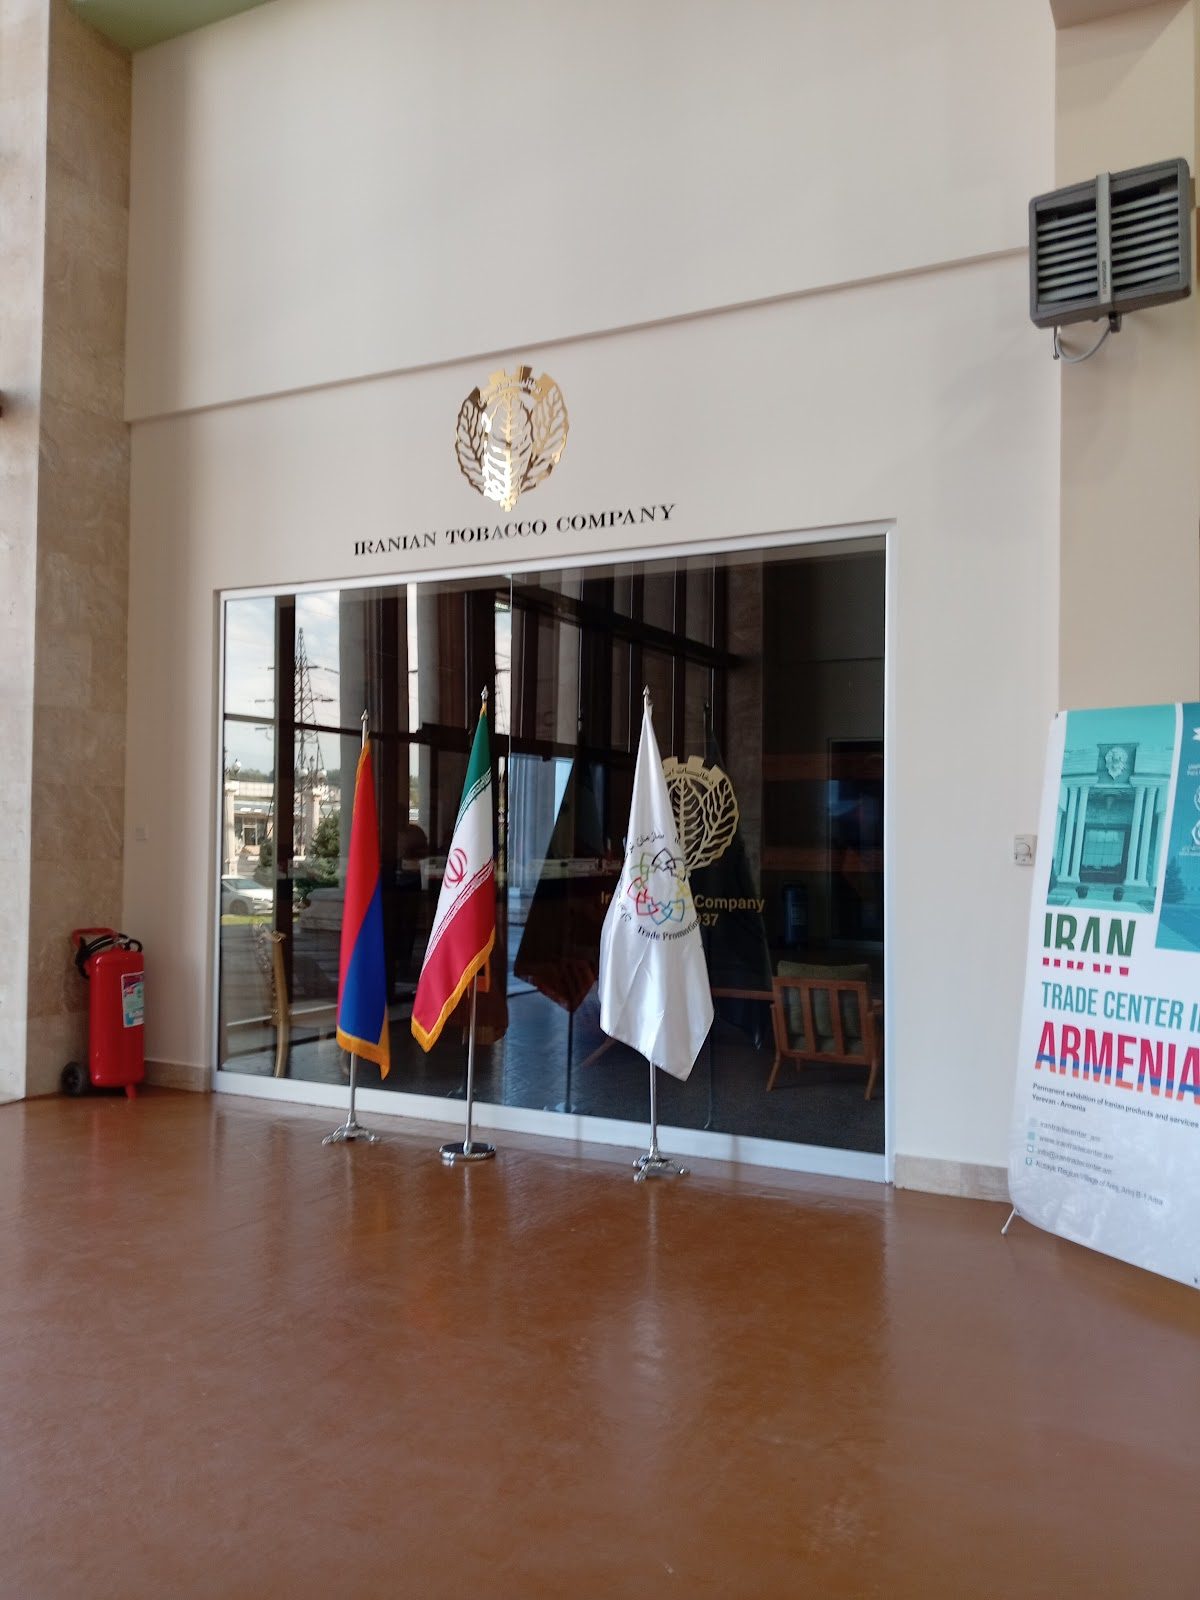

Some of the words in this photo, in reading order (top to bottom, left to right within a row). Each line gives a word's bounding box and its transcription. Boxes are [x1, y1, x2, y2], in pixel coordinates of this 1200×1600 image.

[354, 531, 437, 556] IRANIAN
[446, 520, 547, 545] TOBACCO
[556, 504, 676, 532] COMPANY
[694, 894, 765, 913] Company
[638, 926, 661, 939] Trade
[1043, 912, 1136, 958] IRAN
[1042, 981, 1098, 1016] TRADE
[1104, 991, 1184, 1030] CENTER
[1034, 1021, 1200, 1105] ARMENIA
[1032, 1094, 1056, 1106] Yerevan
[1060, 1100, 1086, 1113] Armenia
[1032, 1082, 1065, 1096] Permanent
[1066, 1091, 1096, 1103] exhibition
[1104, 1099, 1124, 1110] Iranian
[1125, 1105, 1154, 1118] products
[1155, 1113, 1169, 1121] and
[1169, 1116, 1199, 1128] services
